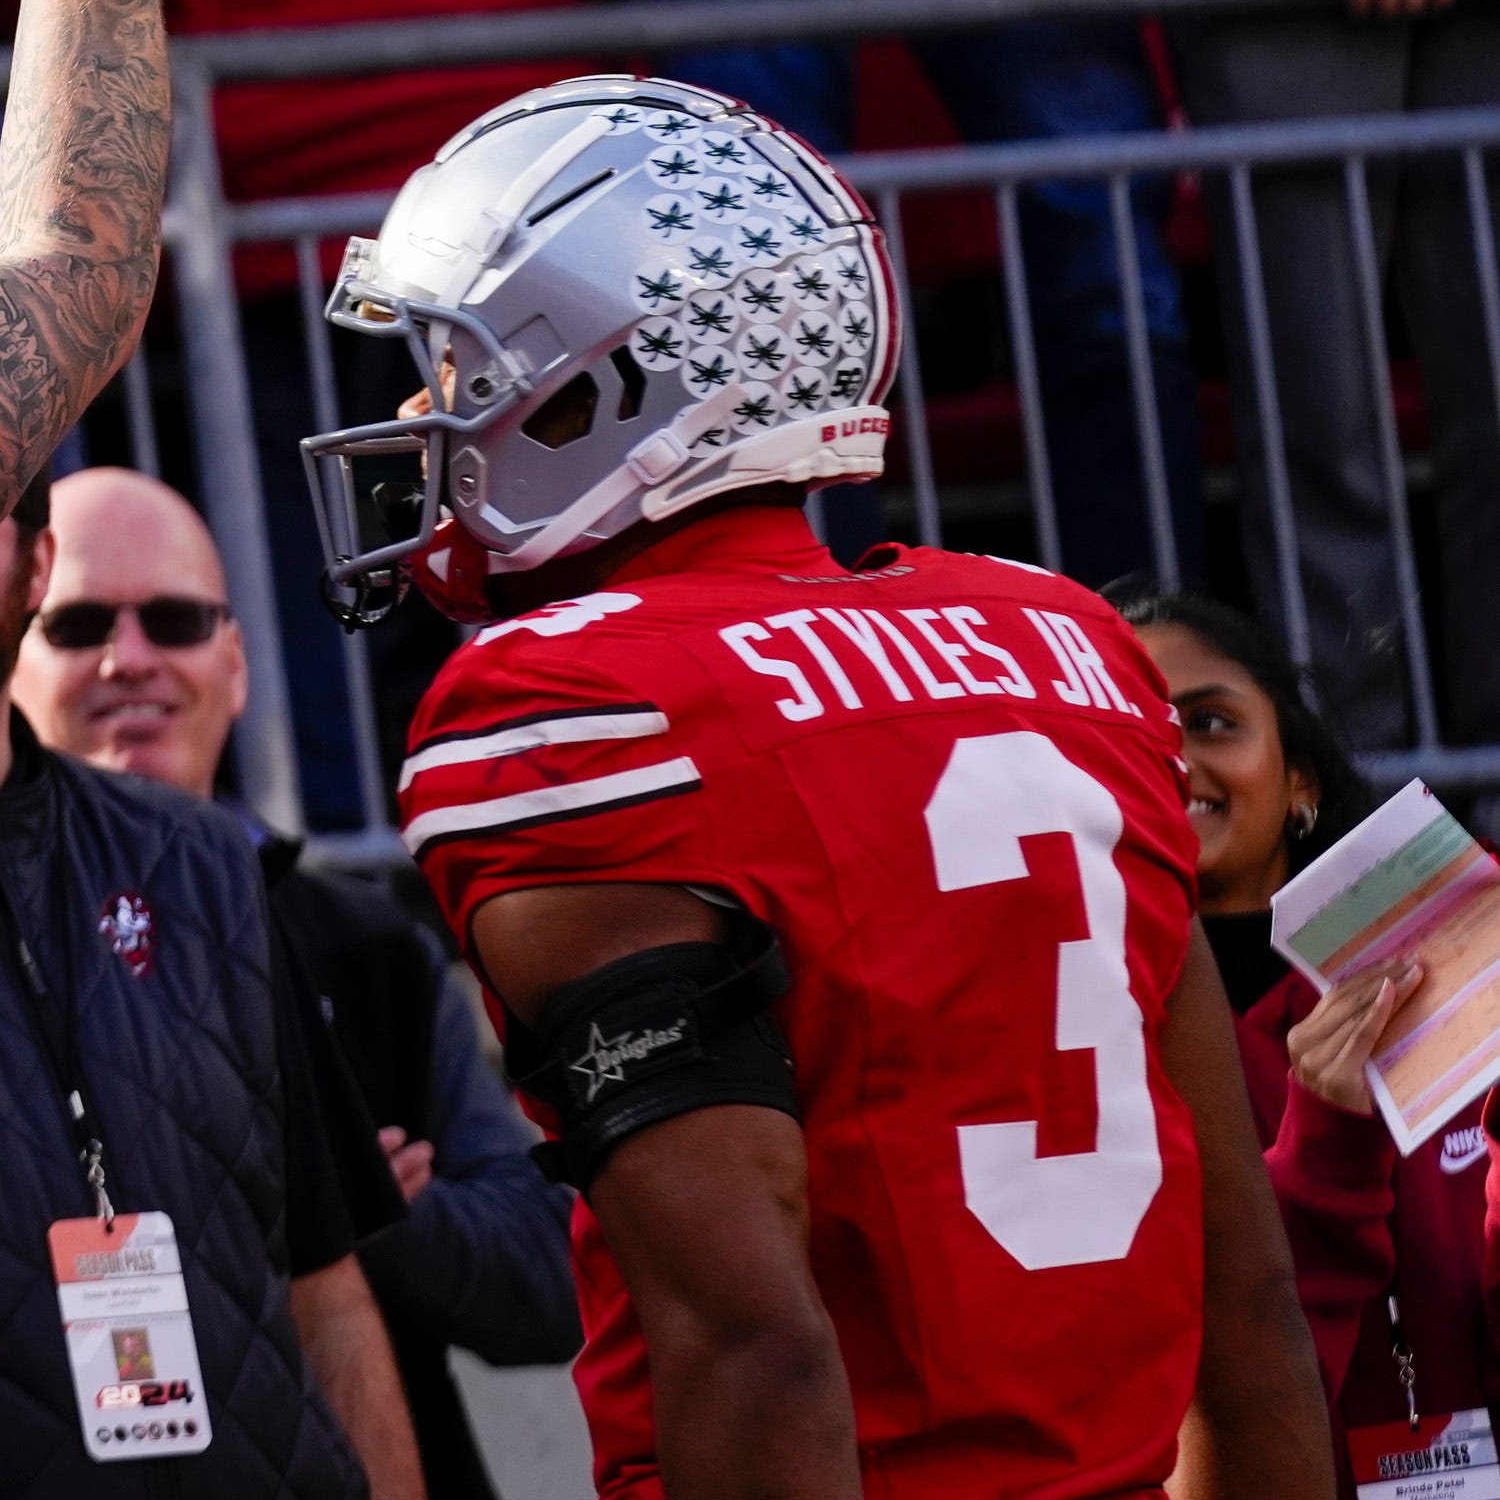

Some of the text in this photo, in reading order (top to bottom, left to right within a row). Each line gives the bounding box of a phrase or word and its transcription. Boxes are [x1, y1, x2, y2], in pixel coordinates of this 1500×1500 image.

[719, 605, 1144, 722] STYLES JR.
[924, 731, 1161, 1271] 3
[595, 1026, 683, 1072] Douglas
[1378, 1443, 1471, 1476] SEASON PASS
